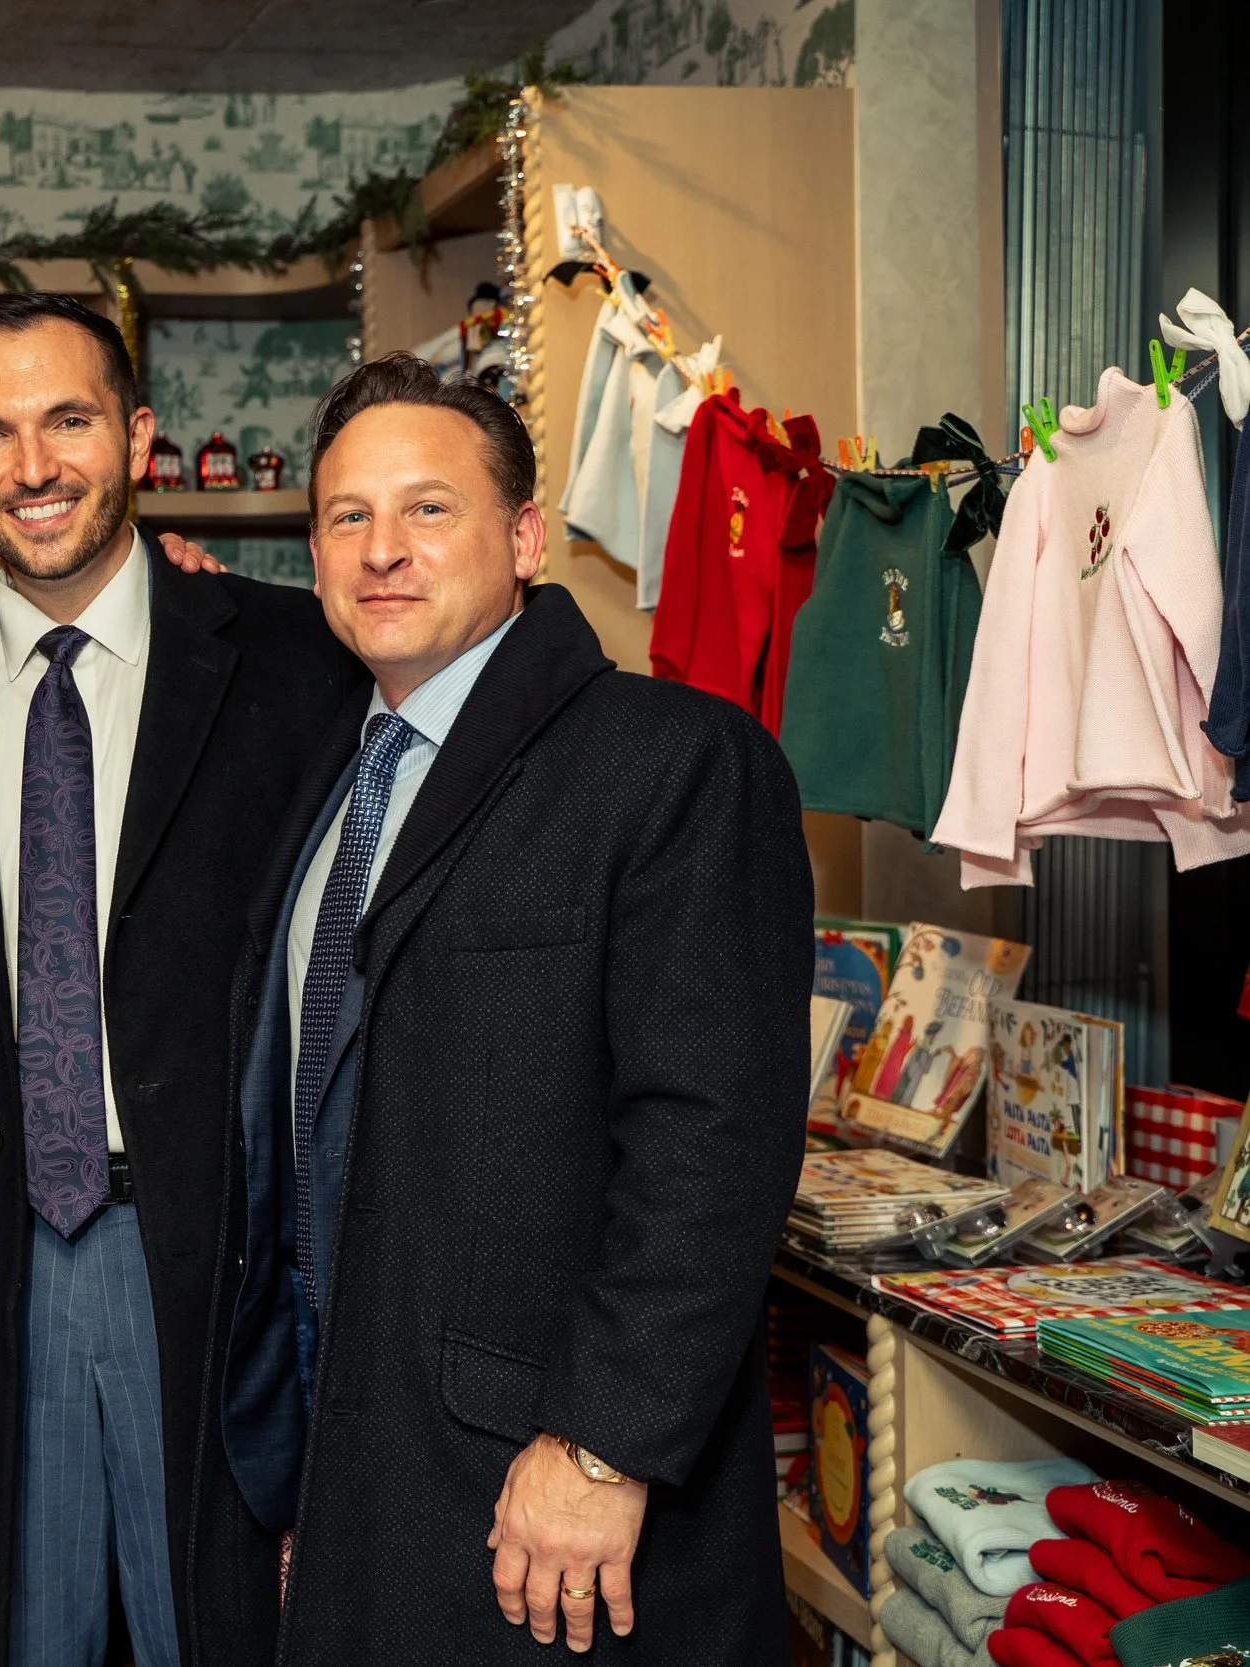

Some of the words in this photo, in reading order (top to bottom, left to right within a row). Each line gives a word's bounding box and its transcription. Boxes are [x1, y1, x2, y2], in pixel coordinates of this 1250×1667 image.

[935, 987, 987, 1023] BEFAN
[1004, 1099, 1024, 1123] PASTA
[1028, 1108, 1050, 1133] PASTA
[1005, 1123, 1025, 1146] LOTTA
[1027, 1132, 1050, 1156] PASTA
